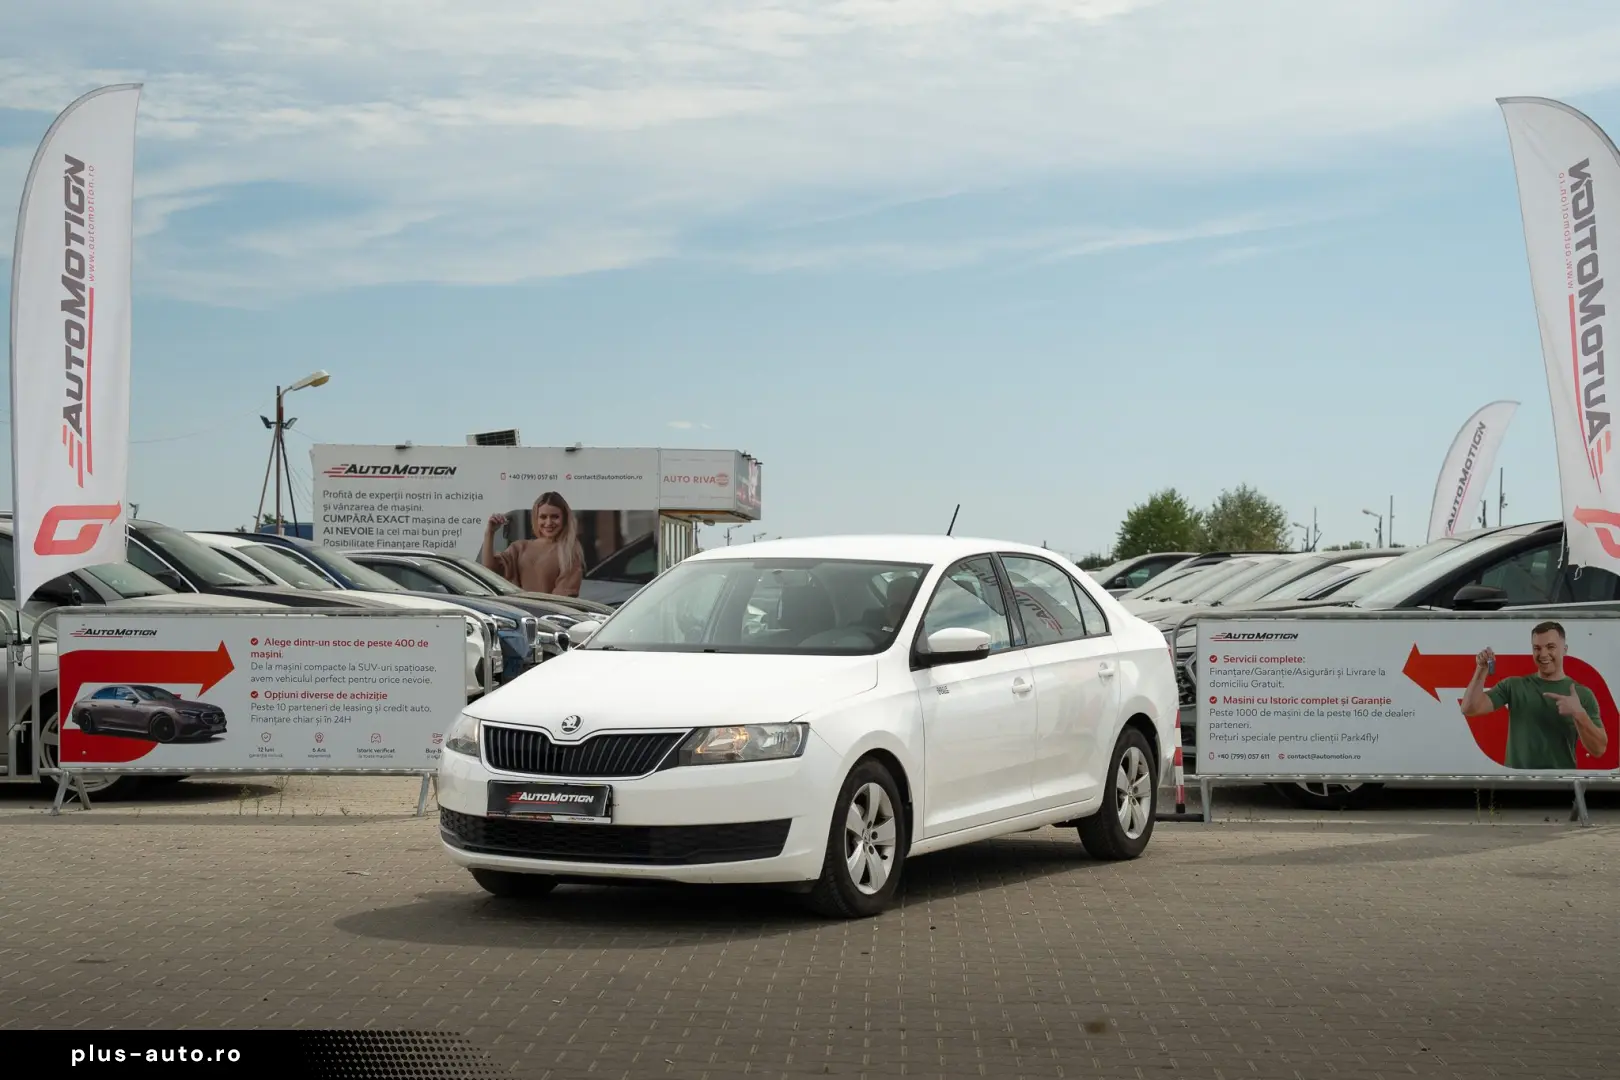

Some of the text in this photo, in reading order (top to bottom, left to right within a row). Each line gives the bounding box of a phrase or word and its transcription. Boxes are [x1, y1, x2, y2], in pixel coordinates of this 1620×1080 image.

[88, 164, 96, 282] www.automotion.ro
[355, 491, 367, 499] de
[323, 514, 374, 524] CUMPĂRĂ
[377, 516, 410, 524] EXACT
[336, 527, 374, 535] NEVOIE
[323, 539, 374, 547] Posibilitate
[264, 638, 428, 649] Alege dintr-un stoc de peste 400 de
[1223, 655, 1305, 666] Servicii complete:
[250, 662, 263, 671] De
[265, 662, 272, 671] la
[304, 664, 346, 673] compacte
[348, 663, 356, 671] la
[358, 663, 392, 672] SUV-uri
[1346, 668, 1376, 676] Livrare
[1378, 668, 1386, 676] la
[275, 674, 312, 683] vehiculul
[315, 675, 345, 684] perfect
[348, 676, 376, 684] pentru
[402, 676, 432, 684] nevoie.
[1210, 680, 1284, 688] domiciliu Gratuit.
[301, 690, 334, 699] diverse
[336, 691, 348, 699] de
[1270, 696, 1299, 705] Istoric
[1301, 696, 1338, 707] complet
[288, 704, 328, 712] parteneri
[330, 703, 341, 711] de
[343, 703, 372, 714] leasing
[384, 704, 408, 712] credit
[1210, 709, 1233, 717] Peste
[1260, 709, 1271, 717] de
[1304, 709, 1315, 717] de
[1317, 709, 1324, 717] la
[1327, 710, 1351, 719] peste
[1371, 709, 1382, 717] de
[1385, 709, 1415, 717] dealeri
[1210, 721, 1252, 730] parteneri.
[1241, 734, 1276, 743] speciale
[1279, 734, 1308, 743] pentru
[1341, 734, 1379, 744] Park4fly!
